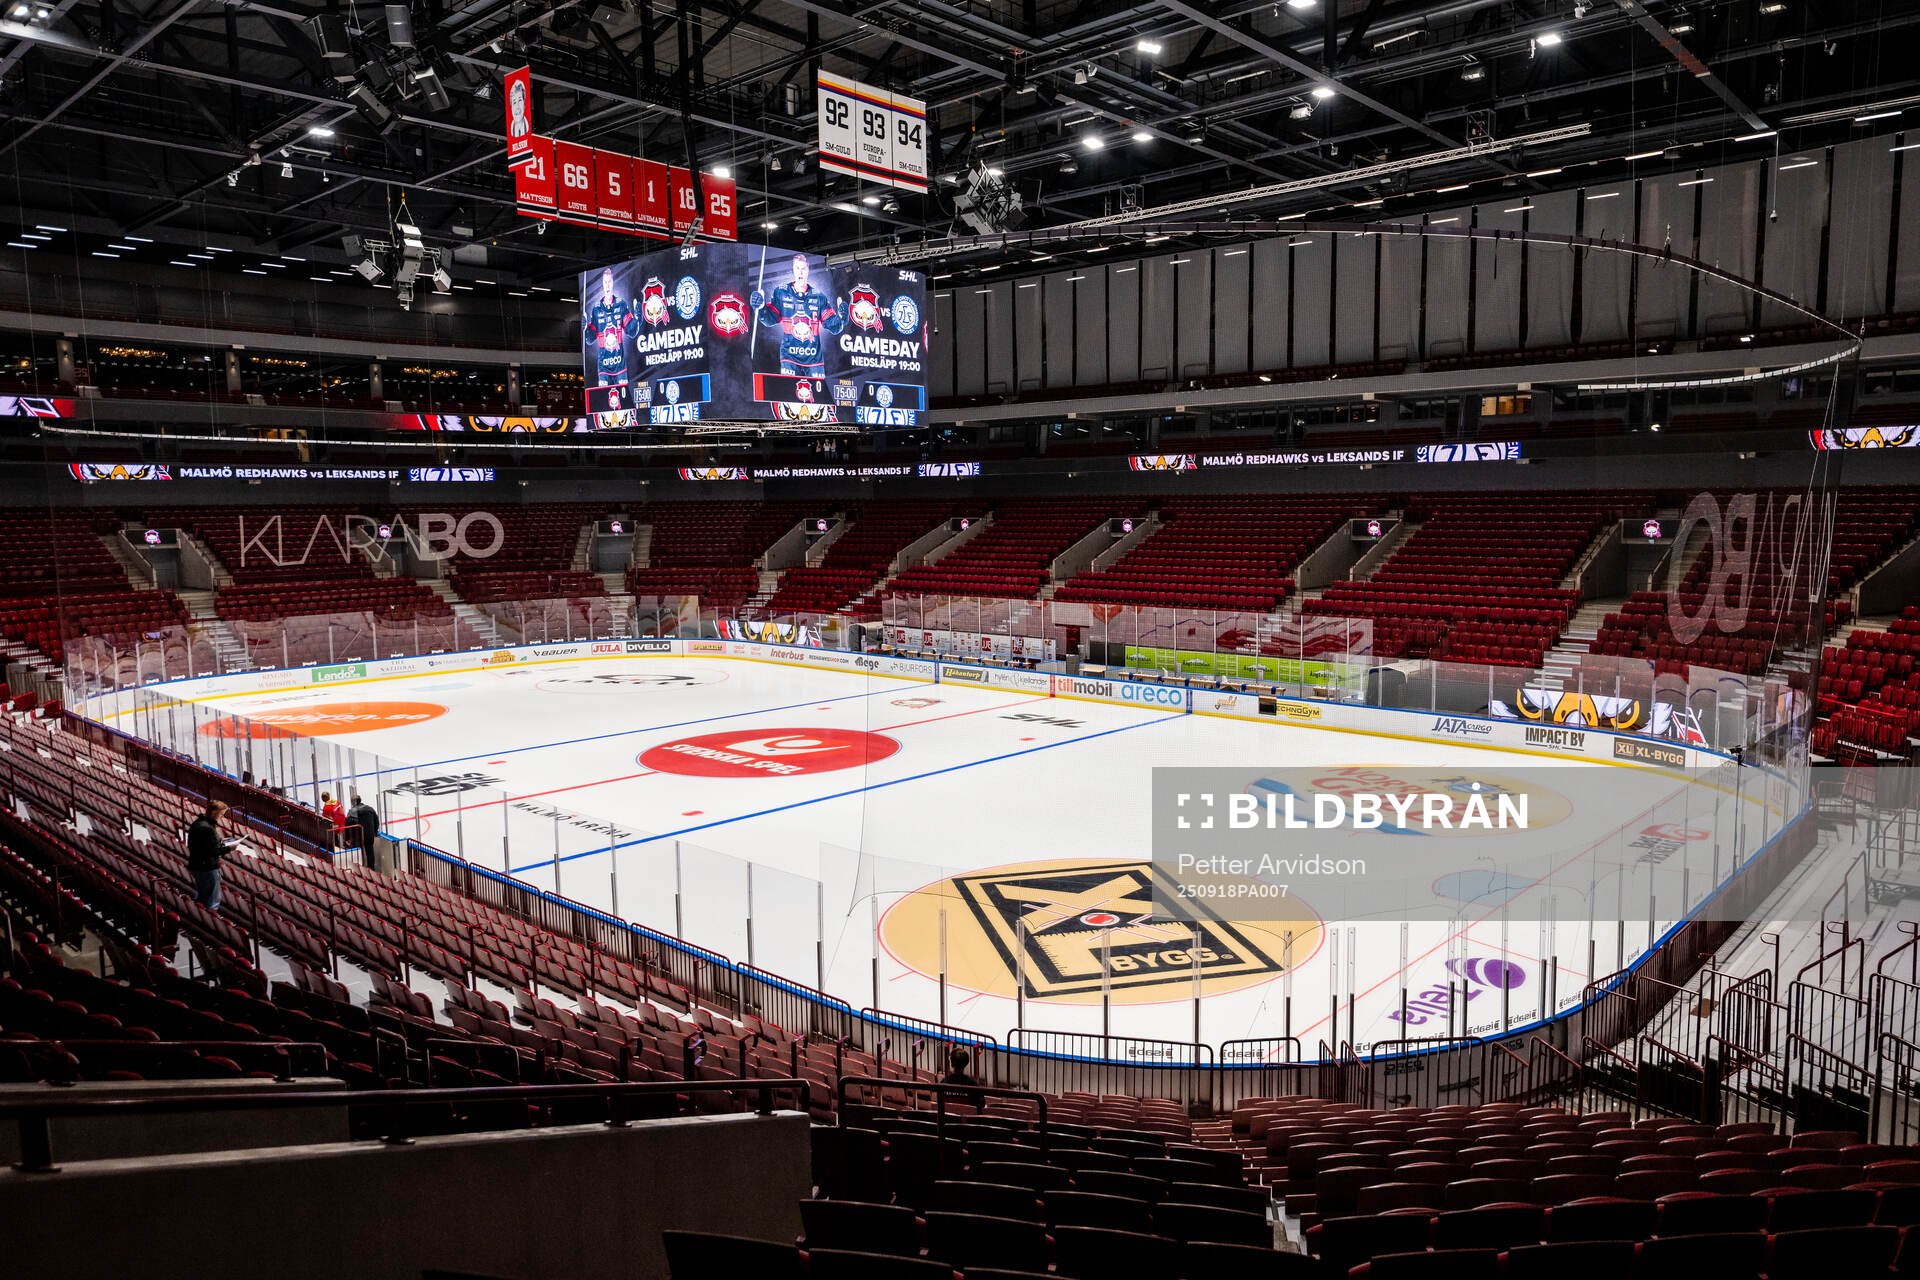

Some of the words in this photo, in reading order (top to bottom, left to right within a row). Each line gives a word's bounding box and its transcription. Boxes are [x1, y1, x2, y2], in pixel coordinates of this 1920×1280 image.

[825, 97, 849, 130] 92
[863, 109, 885, 140] 93
[898, 119, 922, 149] 94
[825, 142, 851, 156] SM-GULD
[863, 143, 887, 156] EUROPA-
[868, 155, 882, 164] GULD
[525, 155, 546, 181] 21
[899, 161, 922, 174] SM-GULD
[563, 162, 588, 190] 66
[608, 171, 621, 196] 5
[520, 192, 553, 204] MATTSSON
[647, 180, 655, 203] 1
[679, 187, 697, 210] 18
[567, 201, 588, 211] LUSTH
[710, 193, 731, 217] 25
[599, 207, 633, 220] NORDSTRÖM
[637, 213, 666, 226] LINDMARK
[680, 246, 699, 261] SHL
[898, 270, 918, 283] SHL
[666, 296, 676, 307] VS
[880, 307, 892, 318] VS
[636, 325, 703, 353] GAMEDAY
[840, 333, 920, 359] GAMEDAY
[645, 349, 683, 366] NEDSLÄPP
[683, 347, 704, 360] 19:00
[788, 346, 817, 356] areco
[602, 354, 622, 366] areco
[851, 355, 897, 370] NEDSLÄPP
[898, 359, 921, 372] 19:00
[621, 386, 626, 399] 0
[659, 382, 665, 394] 0
[815, 380, 822, 393] 0
[868, 384, 875, 397] 0
[1202, 453, 1243, 467] MALMÖ
[1246, 453, 1309, 465] REDHAWKS
[1311, 455, 1325, 464] vs
[1326, 451, 1391, 463] LEKSANDS
[1392, 450, 1405, 461] IF
[180, 466, 232, 479] MALMÖ
[235, 469, 307, 480] REDHAWKS
[310, 472, 324, 480] vs
[325, 469, 387, 480] LEKSANDS
[388, 470, 400, 480] IF
[753, 467, 790, 478] MALMÖ
[792, 467, 845, 478] REDHAWKS
[846, 468, 857, 477] vs
[857, 467, 902, 477] LEKSANDS
[903, 466, 911, 476] IF
[540, 648, 578, 657] BAUER
[592, 643, 621, 653] JULA
[627, 643, 671, 652] DIVELLO
[771, 649, 805, 661] Interbus
[899, 663, 932, 674] BJURFORS
[318, 672, 350, 682] Lendo
[1058, 678, 1113, 697] tillmobil
[1121, 684, 1182, 705] areco
[998, 713, 1088, 729] SHL
[1432, 717, 1467, 735] JATA
[1466, 723, 1492, 734] CARGO
[1525, 727, 1569, 746] IMPACT
[1570, 733, 1585, 747] BY
[662, 744, 756, 765] SVENSKA
[744, 760, 805, 775] SPEL
[1617, 743, 1633, 755] XL
[1636, 747, 1684, 765] XL-BYGG
[511, 801, 572, 821] MALMÖ
[568, 819, 633, 839] ARENA
[1108, 947, 1219, 972] BYGG
